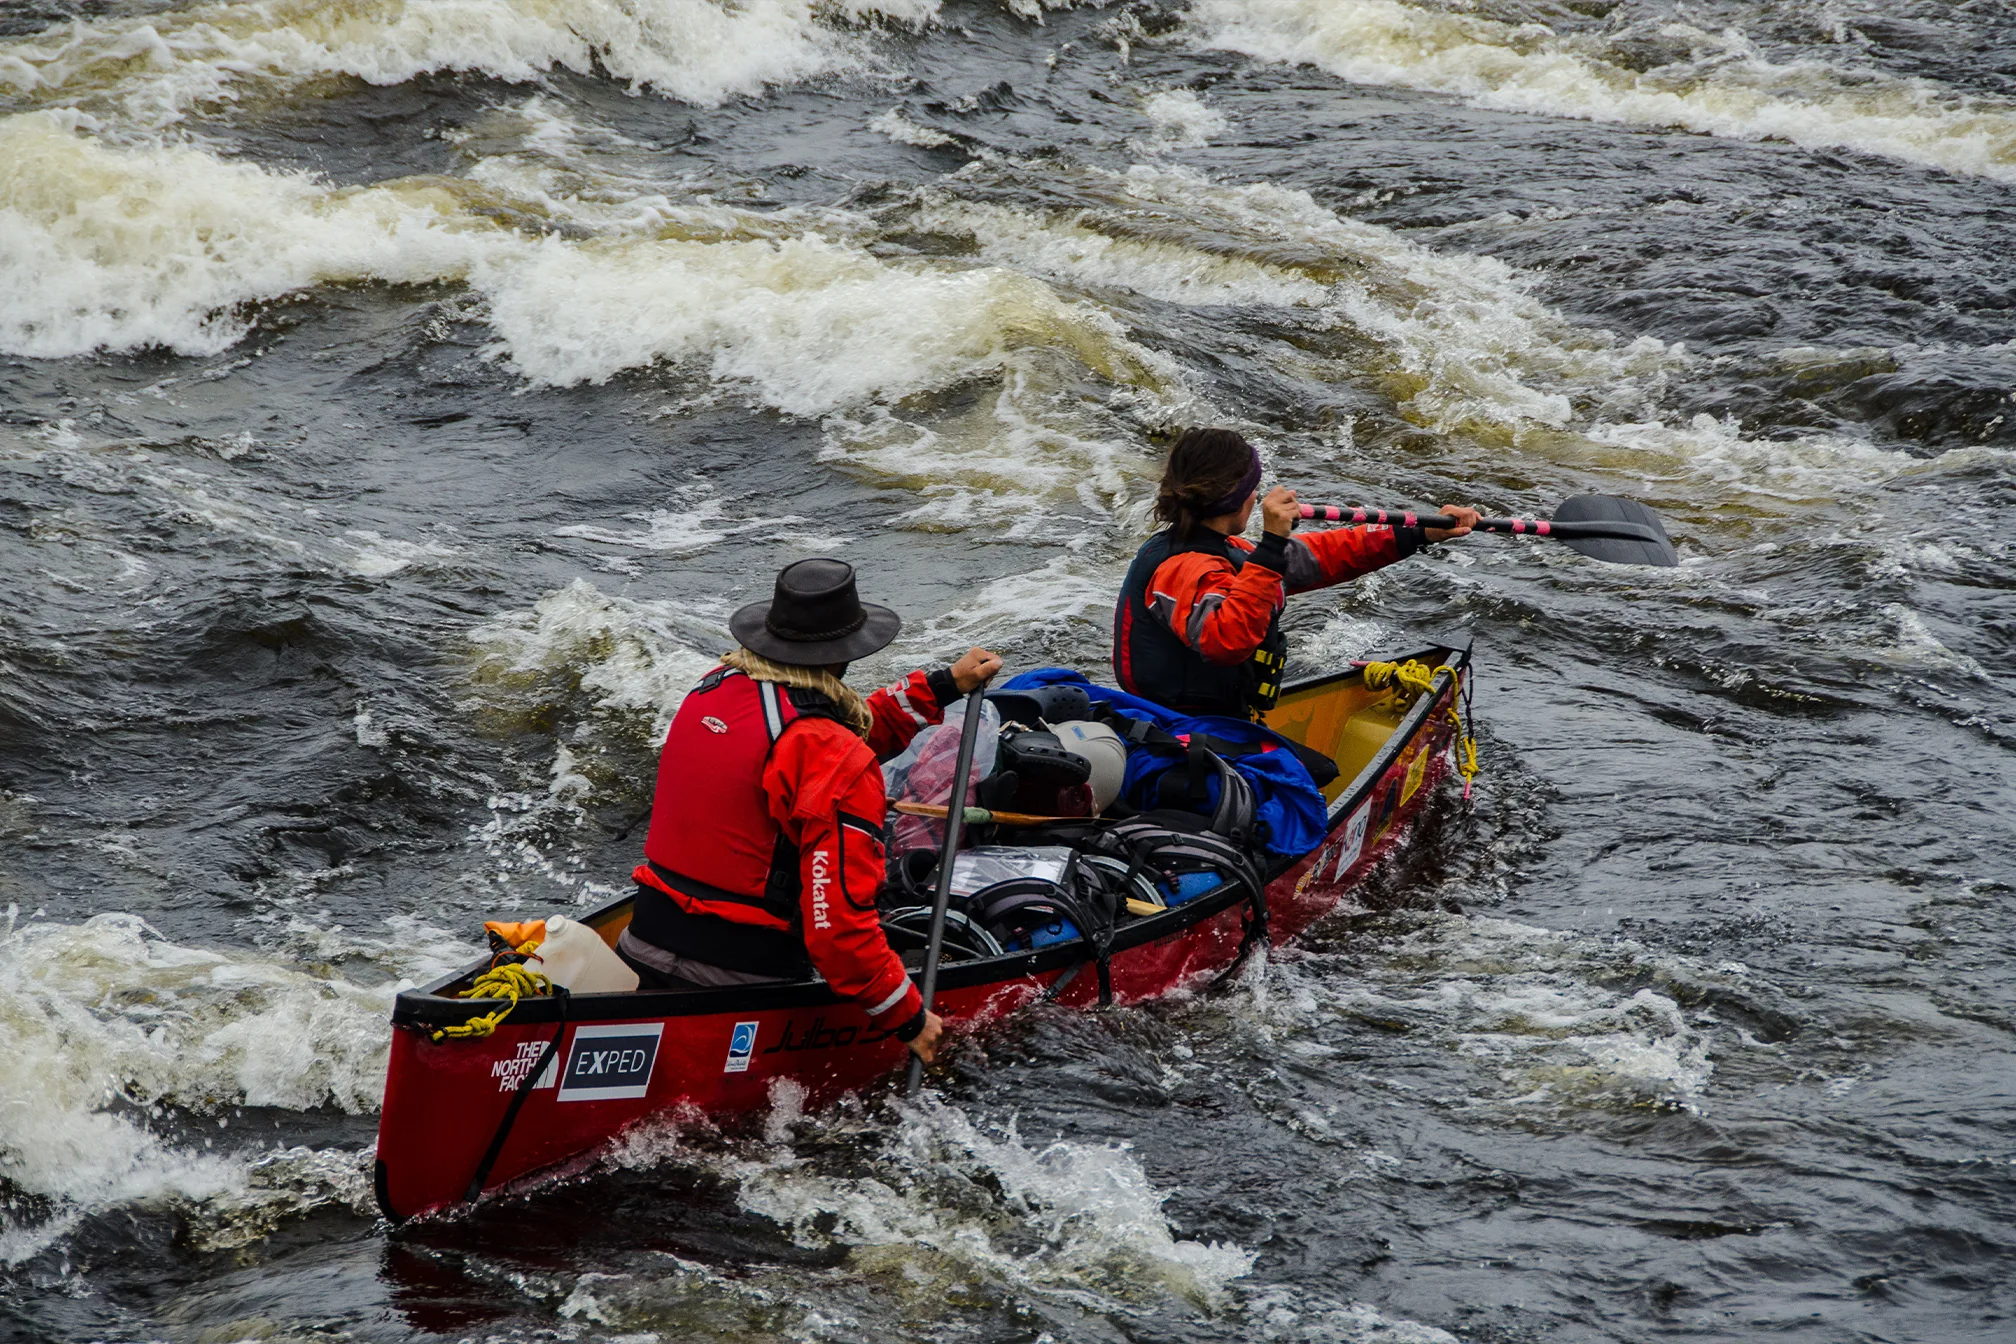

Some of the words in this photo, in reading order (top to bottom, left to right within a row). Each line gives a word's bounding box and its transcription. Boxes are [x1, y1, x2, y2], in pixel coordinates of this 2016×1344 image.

[812, 850, 831, 929] Kōkatat
[762, 1016, 857, 1053] Julbo
[516, 1040, 542, 1059] THE
[490, 1057, 538, 1078] NORTH
[575, 1049, 646, 1075] EXPED
[498, 1074, 528, 1093] FAC
